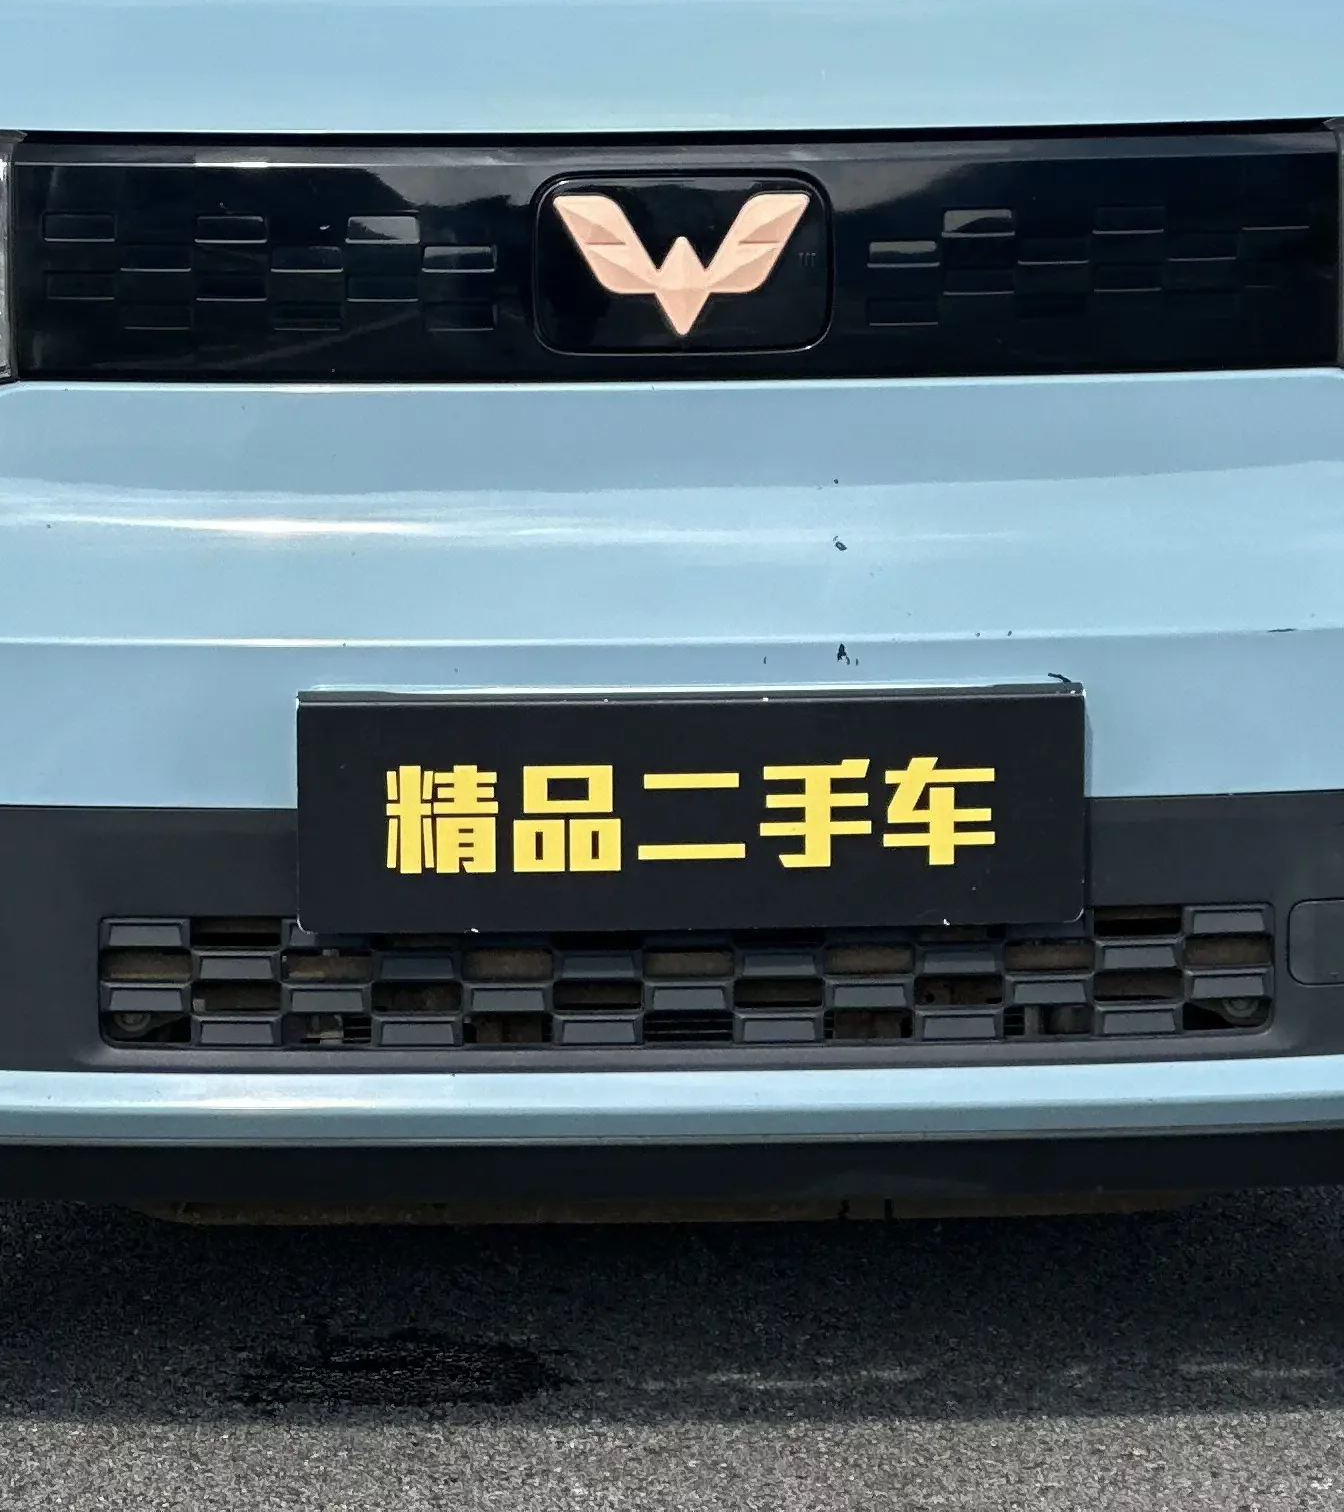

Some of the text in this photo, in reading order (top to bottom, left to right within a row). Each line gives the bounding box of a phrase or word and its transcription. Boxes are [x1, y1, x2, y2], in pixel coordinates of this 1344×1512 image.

[387, 757, 995, 873] 精品二手车
